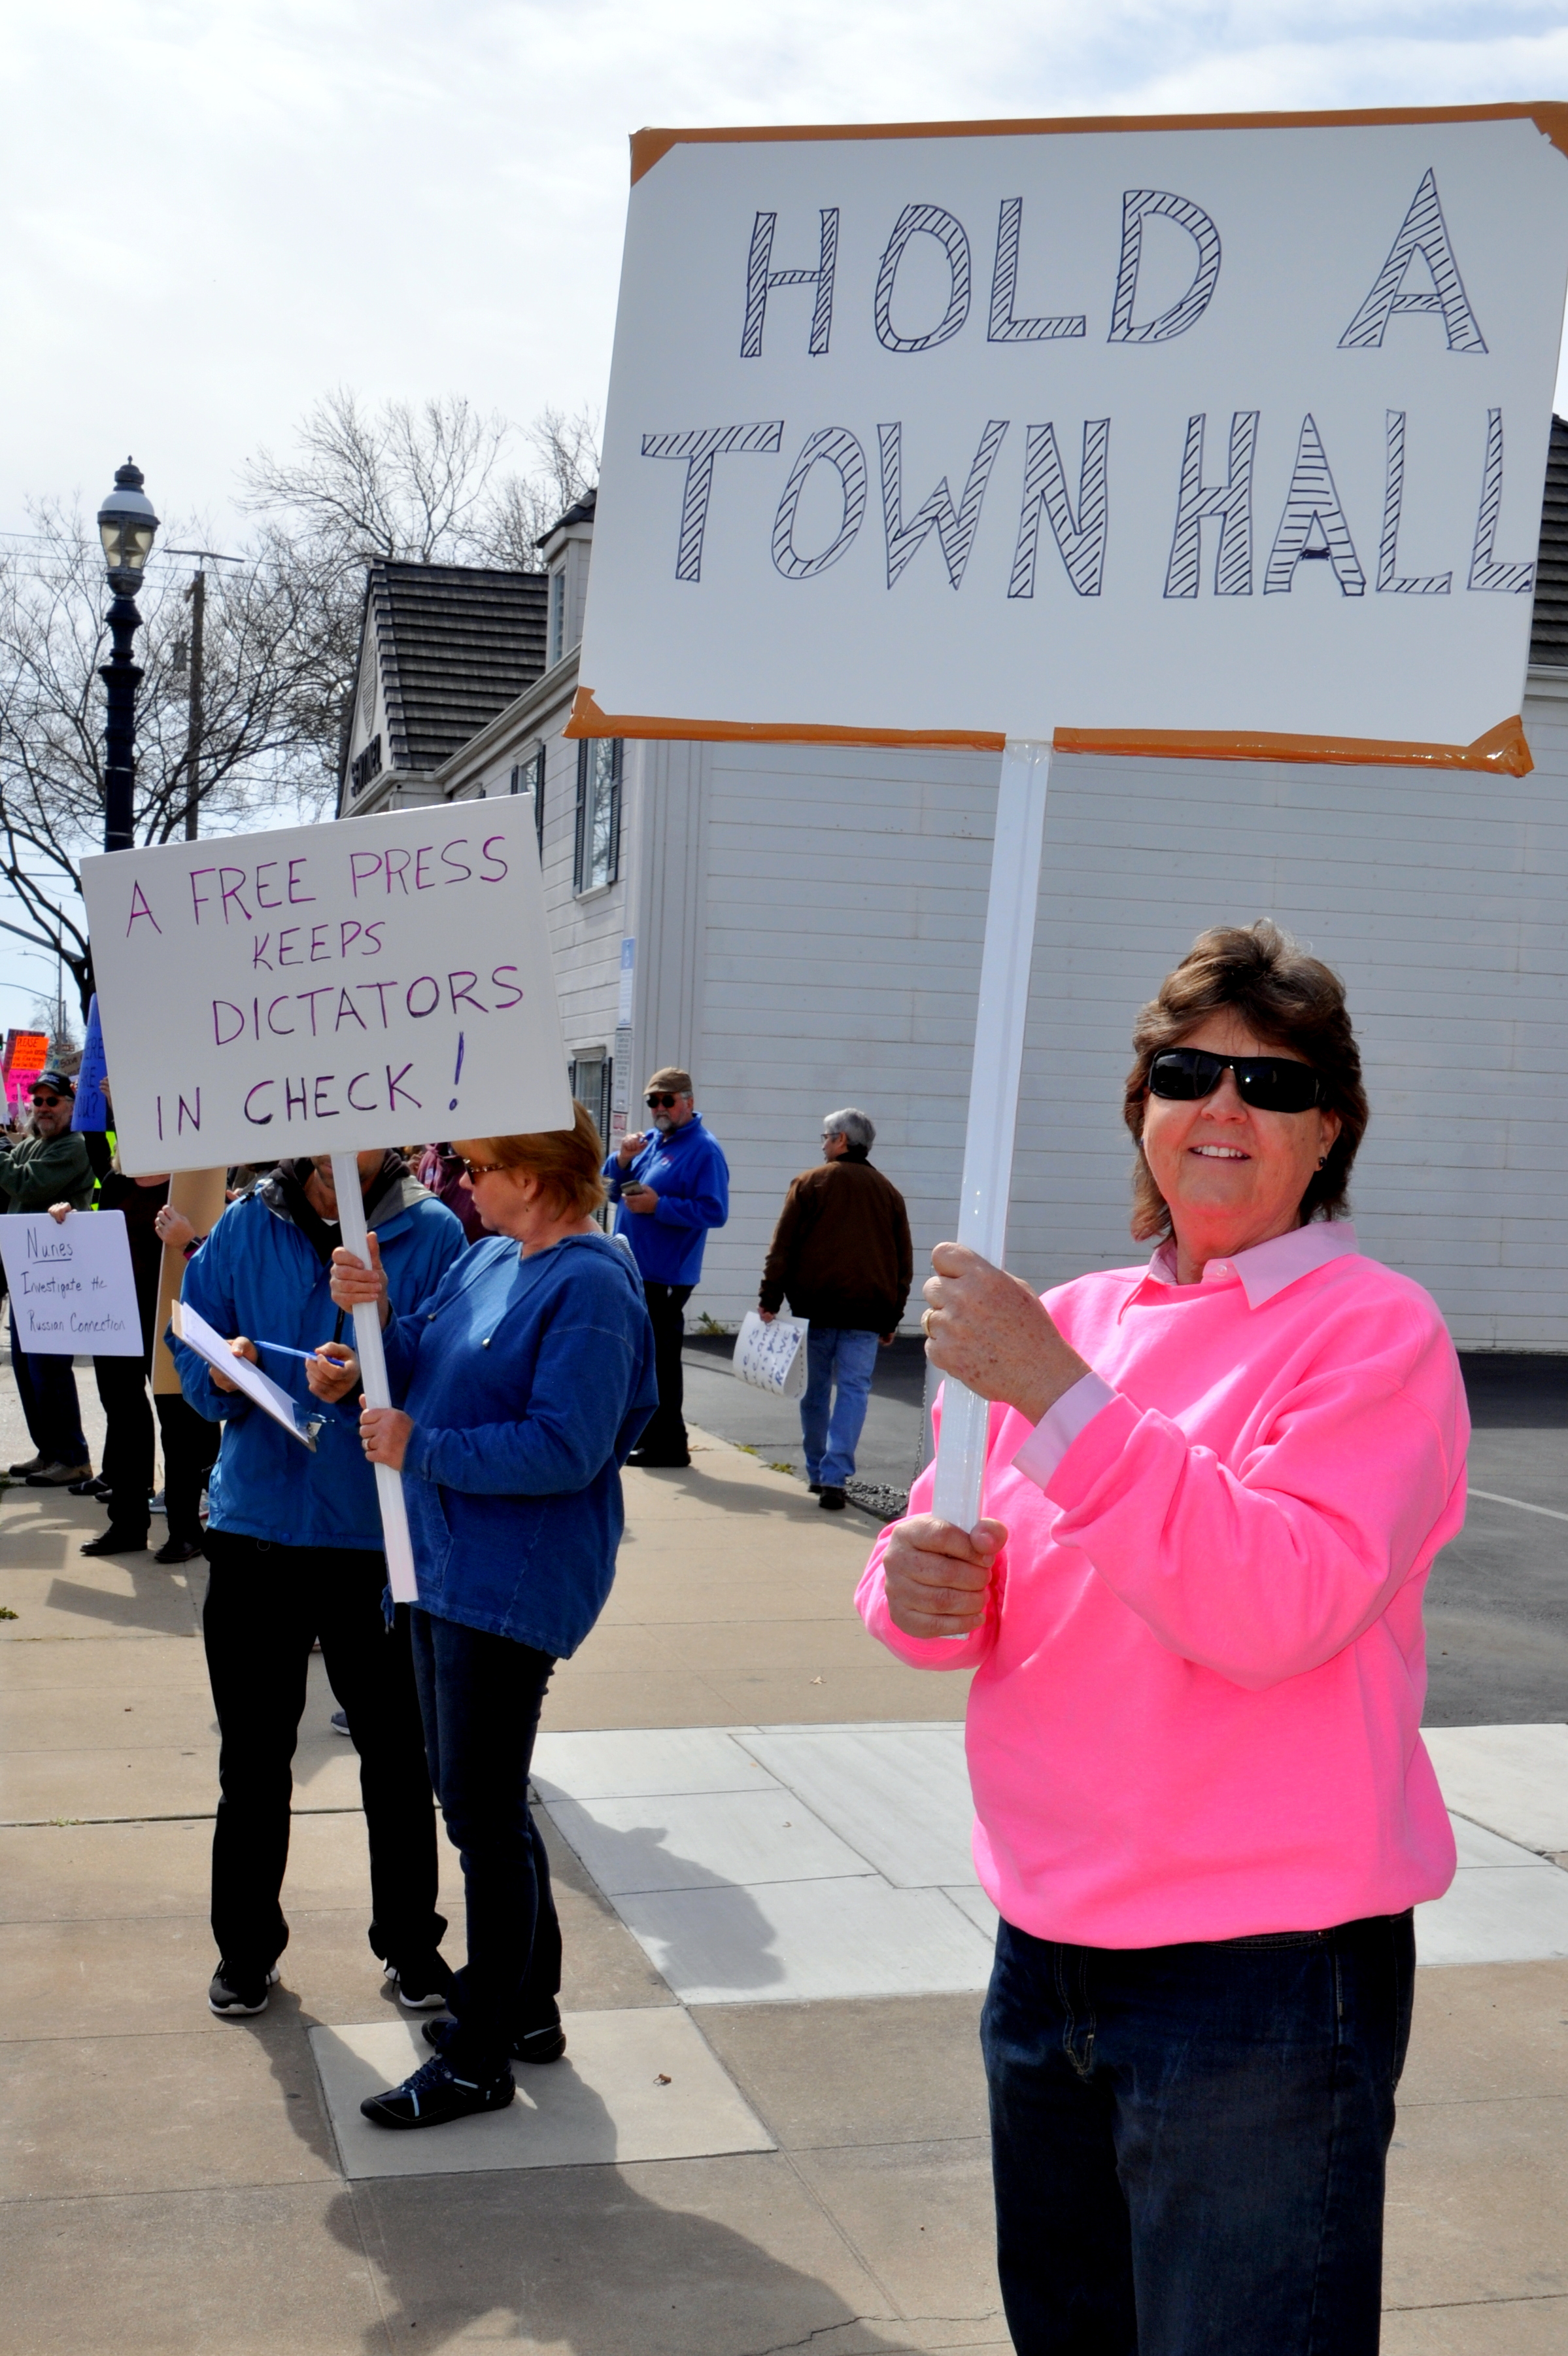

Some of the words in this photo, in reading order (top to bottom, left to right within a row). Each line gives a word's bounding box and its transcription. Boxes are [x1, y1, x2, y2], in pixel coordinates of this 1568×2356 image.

[740, 190, 1221, 358] HOLD
[1337, 167, 1489, 354] A
[641, 417, 1111, 598] TOWN
[1163, 407, 1534, 598] HALL
[127, 880, 162, 937] A
[189, 858, 316, 926] FREE
[350, 837, 508, 898] PRESS
[252, 921, 385, 971] KEEPS
[213, 965, 523, 1046] DICTATORS
[156, 1086, 200, 1141] IN
[27, 1227, 73, 1258] Nunes
[20, 1271, 82, 1298] Investigate
[92, 1276, 107, 1291] the
[27, 1309, 64, 1332] Russian
[70, 1313, 126, 1332] Connection
